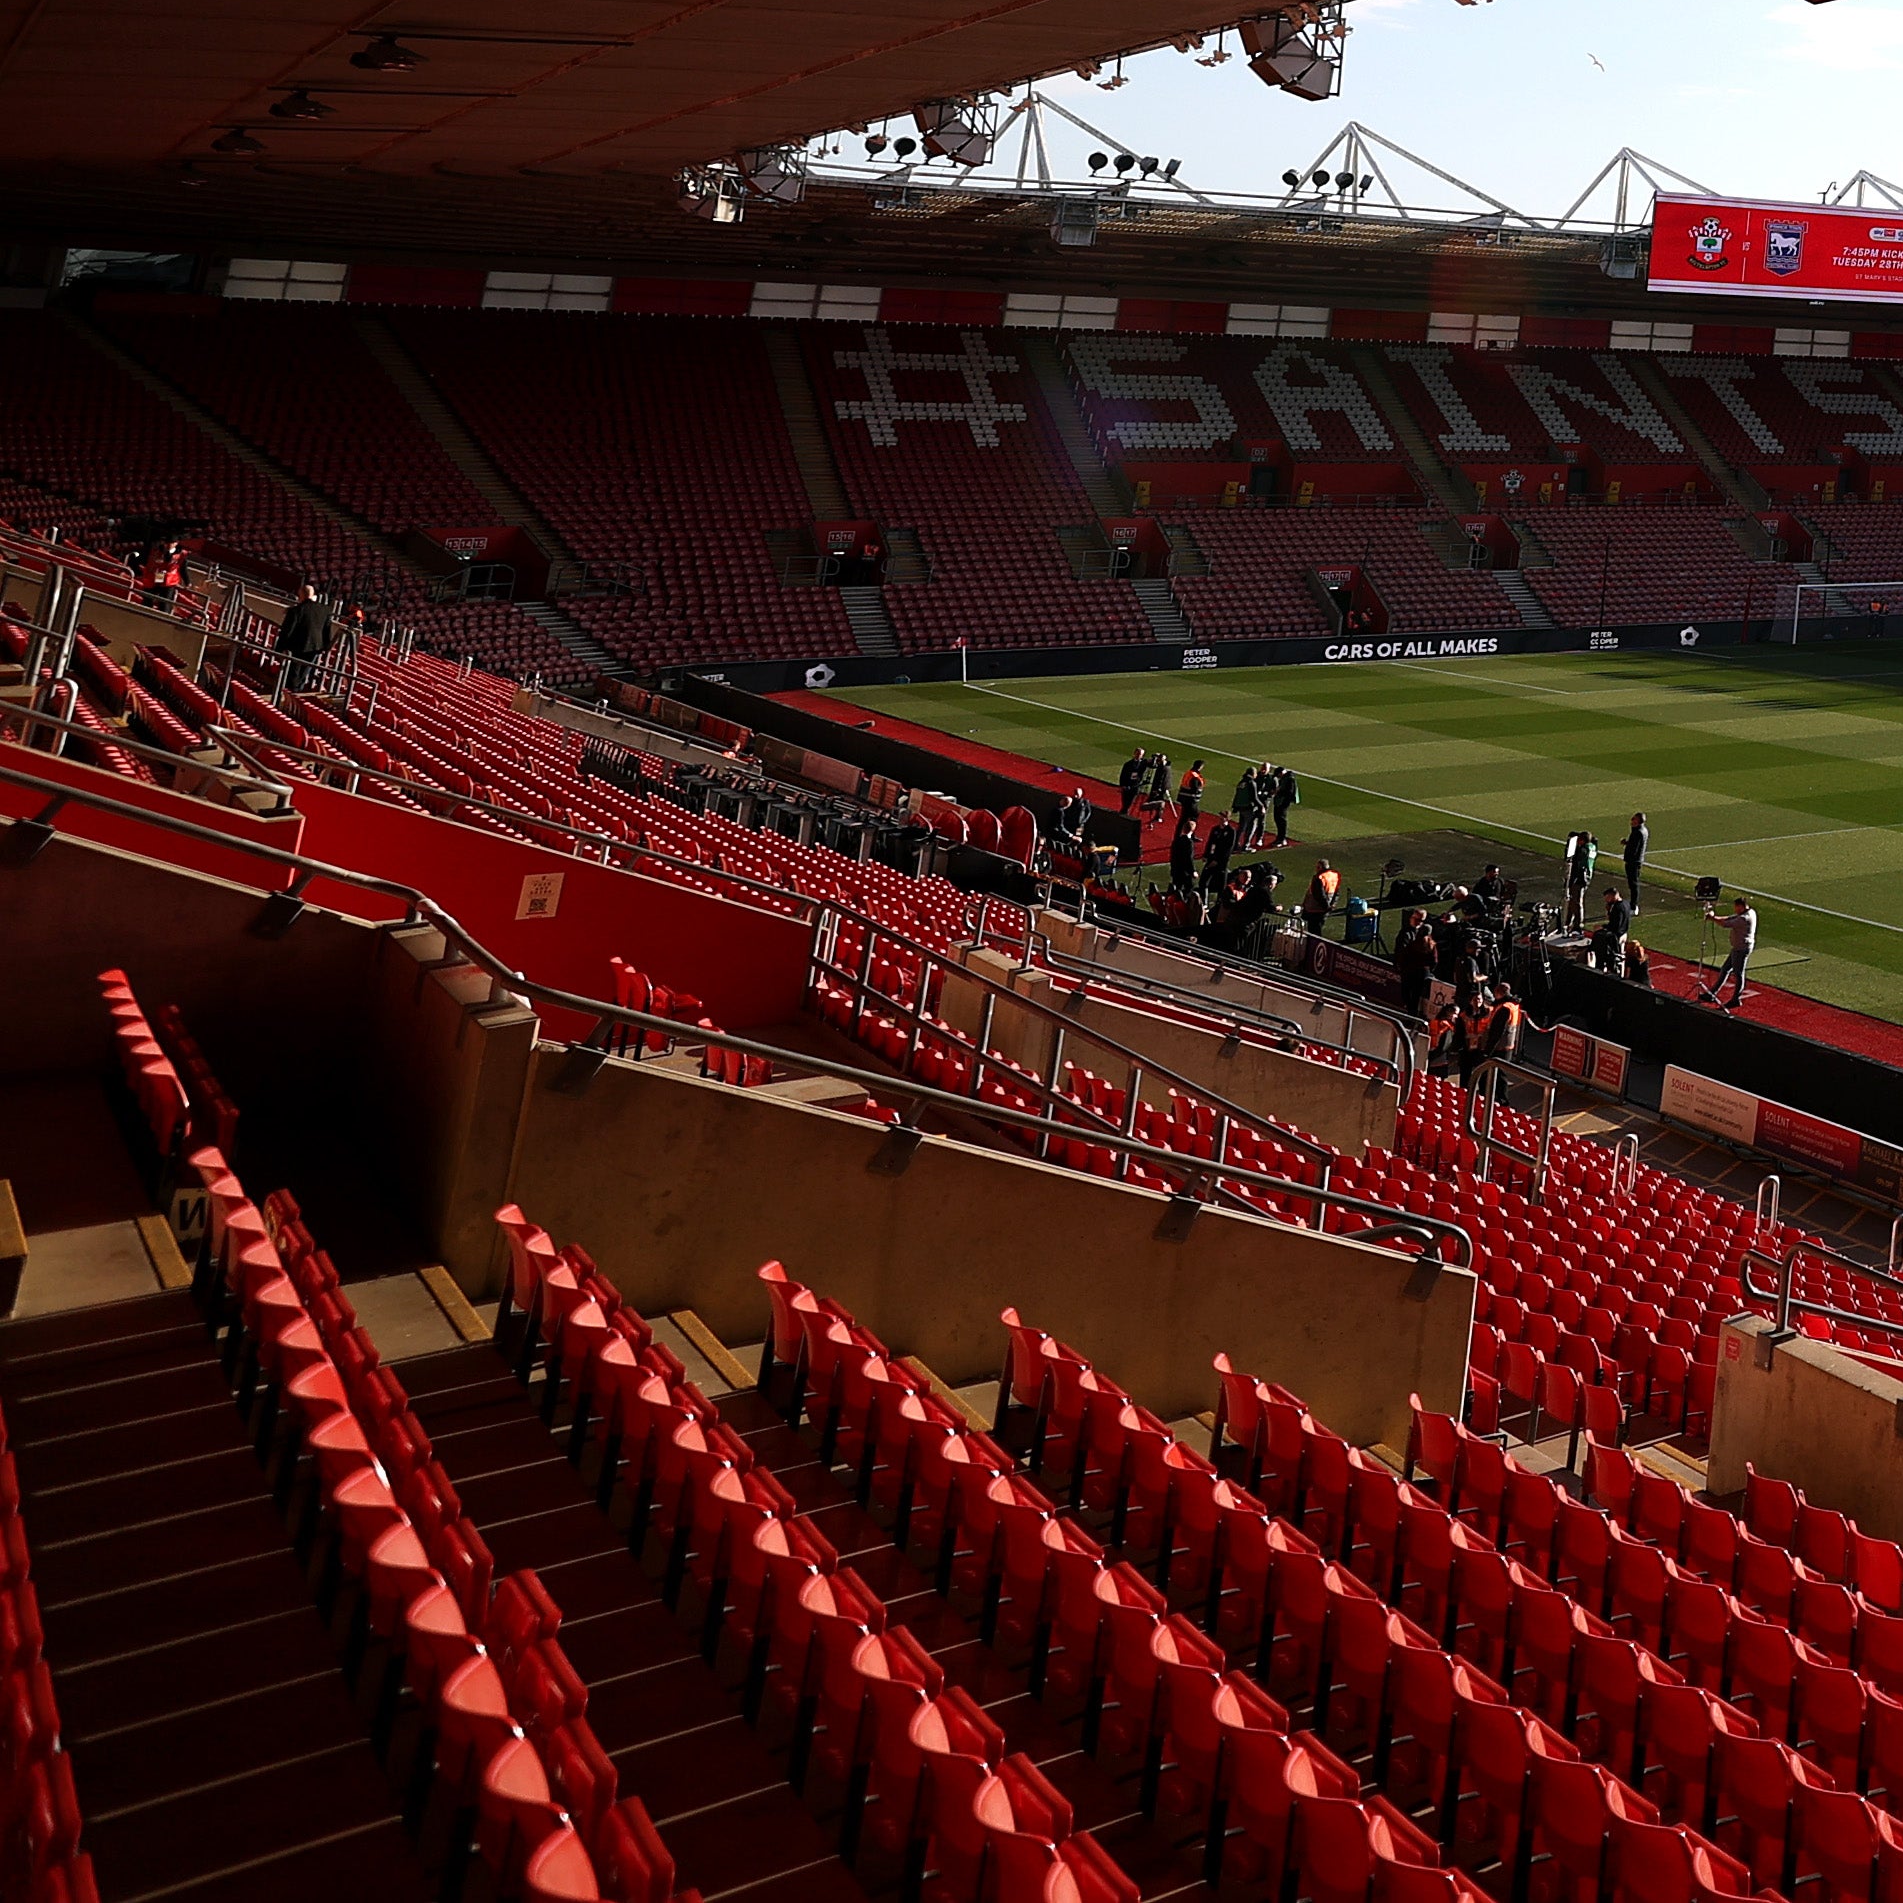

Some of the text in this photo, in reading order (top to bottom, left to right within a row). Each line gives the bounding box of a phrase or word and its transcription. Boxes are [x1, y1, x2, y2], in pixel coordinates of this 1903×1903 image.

[1842, 247, 1879, 258] 7:45PM
[1881, 249, 1903, 260] KICK
[1832, 256, 1877, 268] TUESDAY
[1879, 260, 1903, 270] 28TH
[1324, 638, 1498, 660] CARS OF ALL MAKES
[1671, 1078, 1694, 1094] SOLENT
[1764, 1110, 1790, 1128] SOLENT
